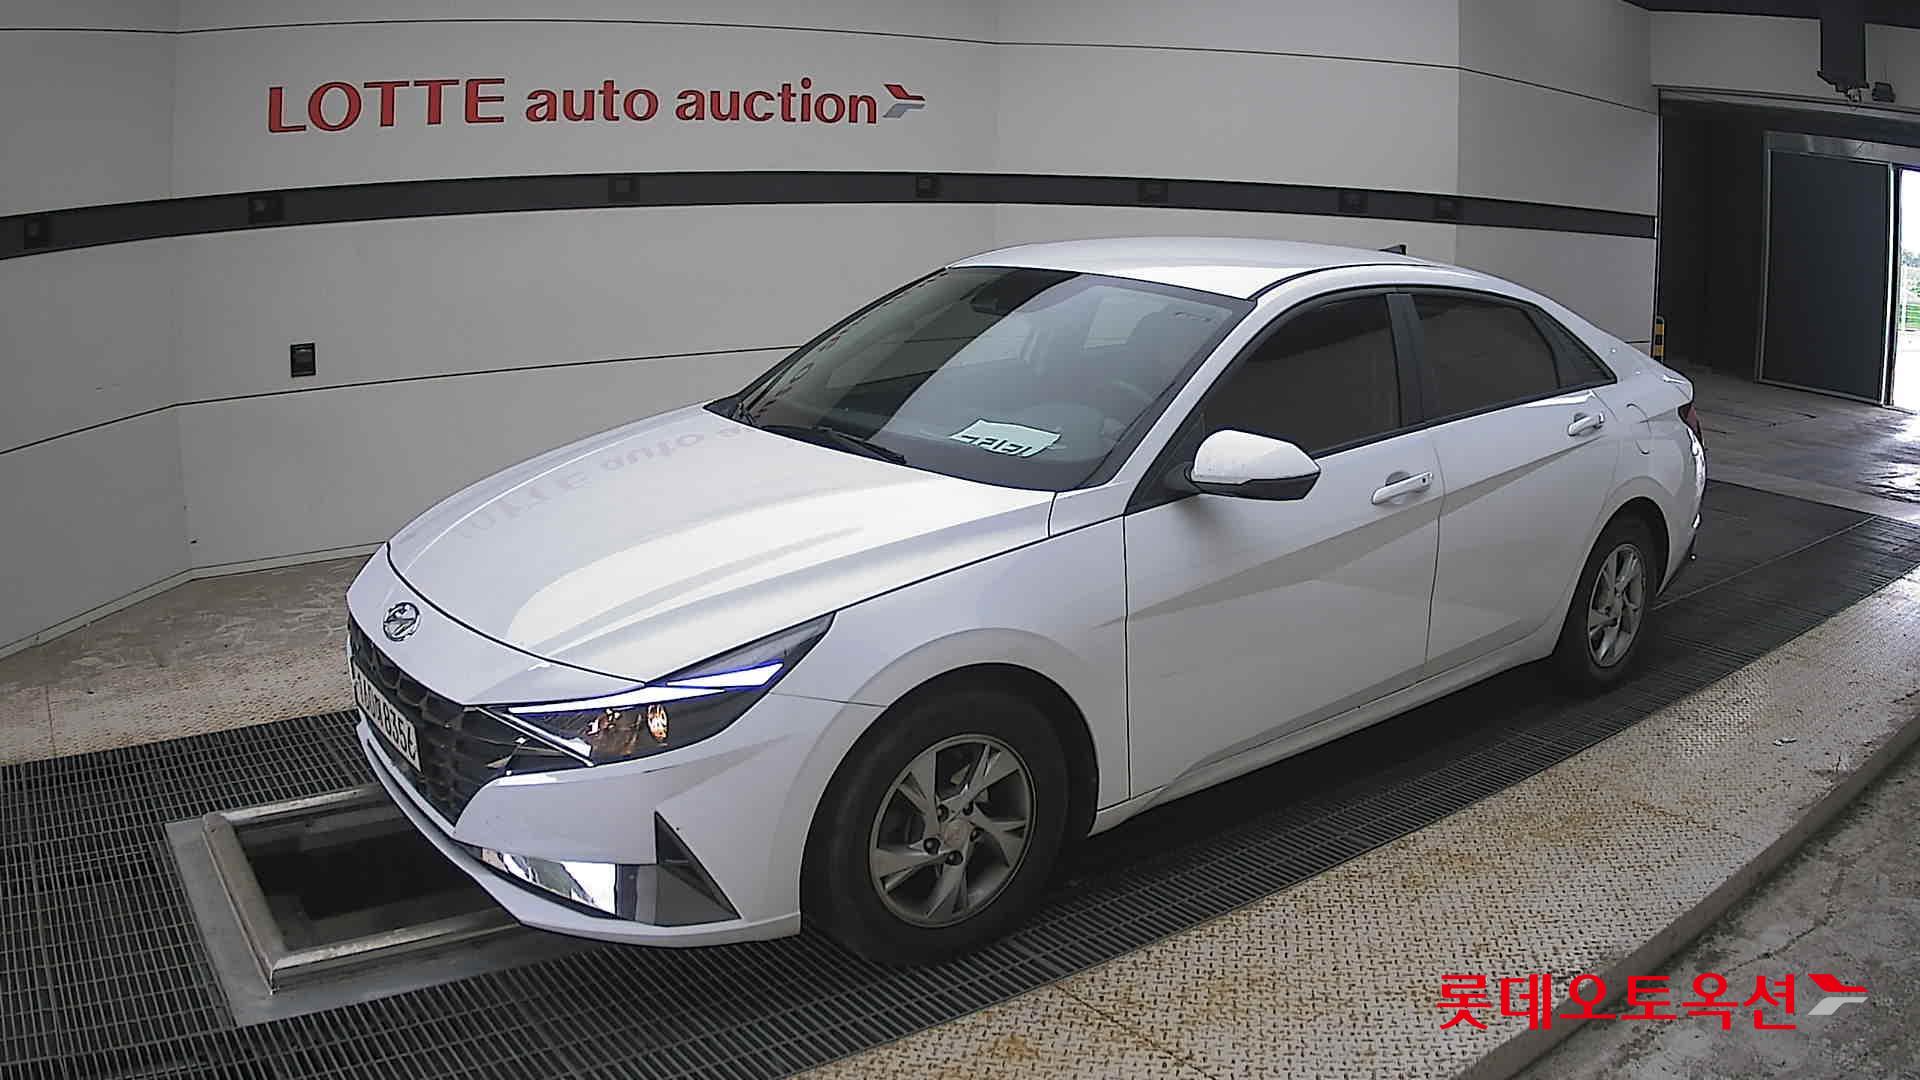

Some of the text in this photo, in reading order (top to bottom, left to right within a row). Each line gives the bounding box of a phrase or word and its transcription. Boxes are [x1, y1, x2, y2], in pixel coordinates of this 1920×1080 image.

[268, 77, 879, 132] LOTTE auto auction
